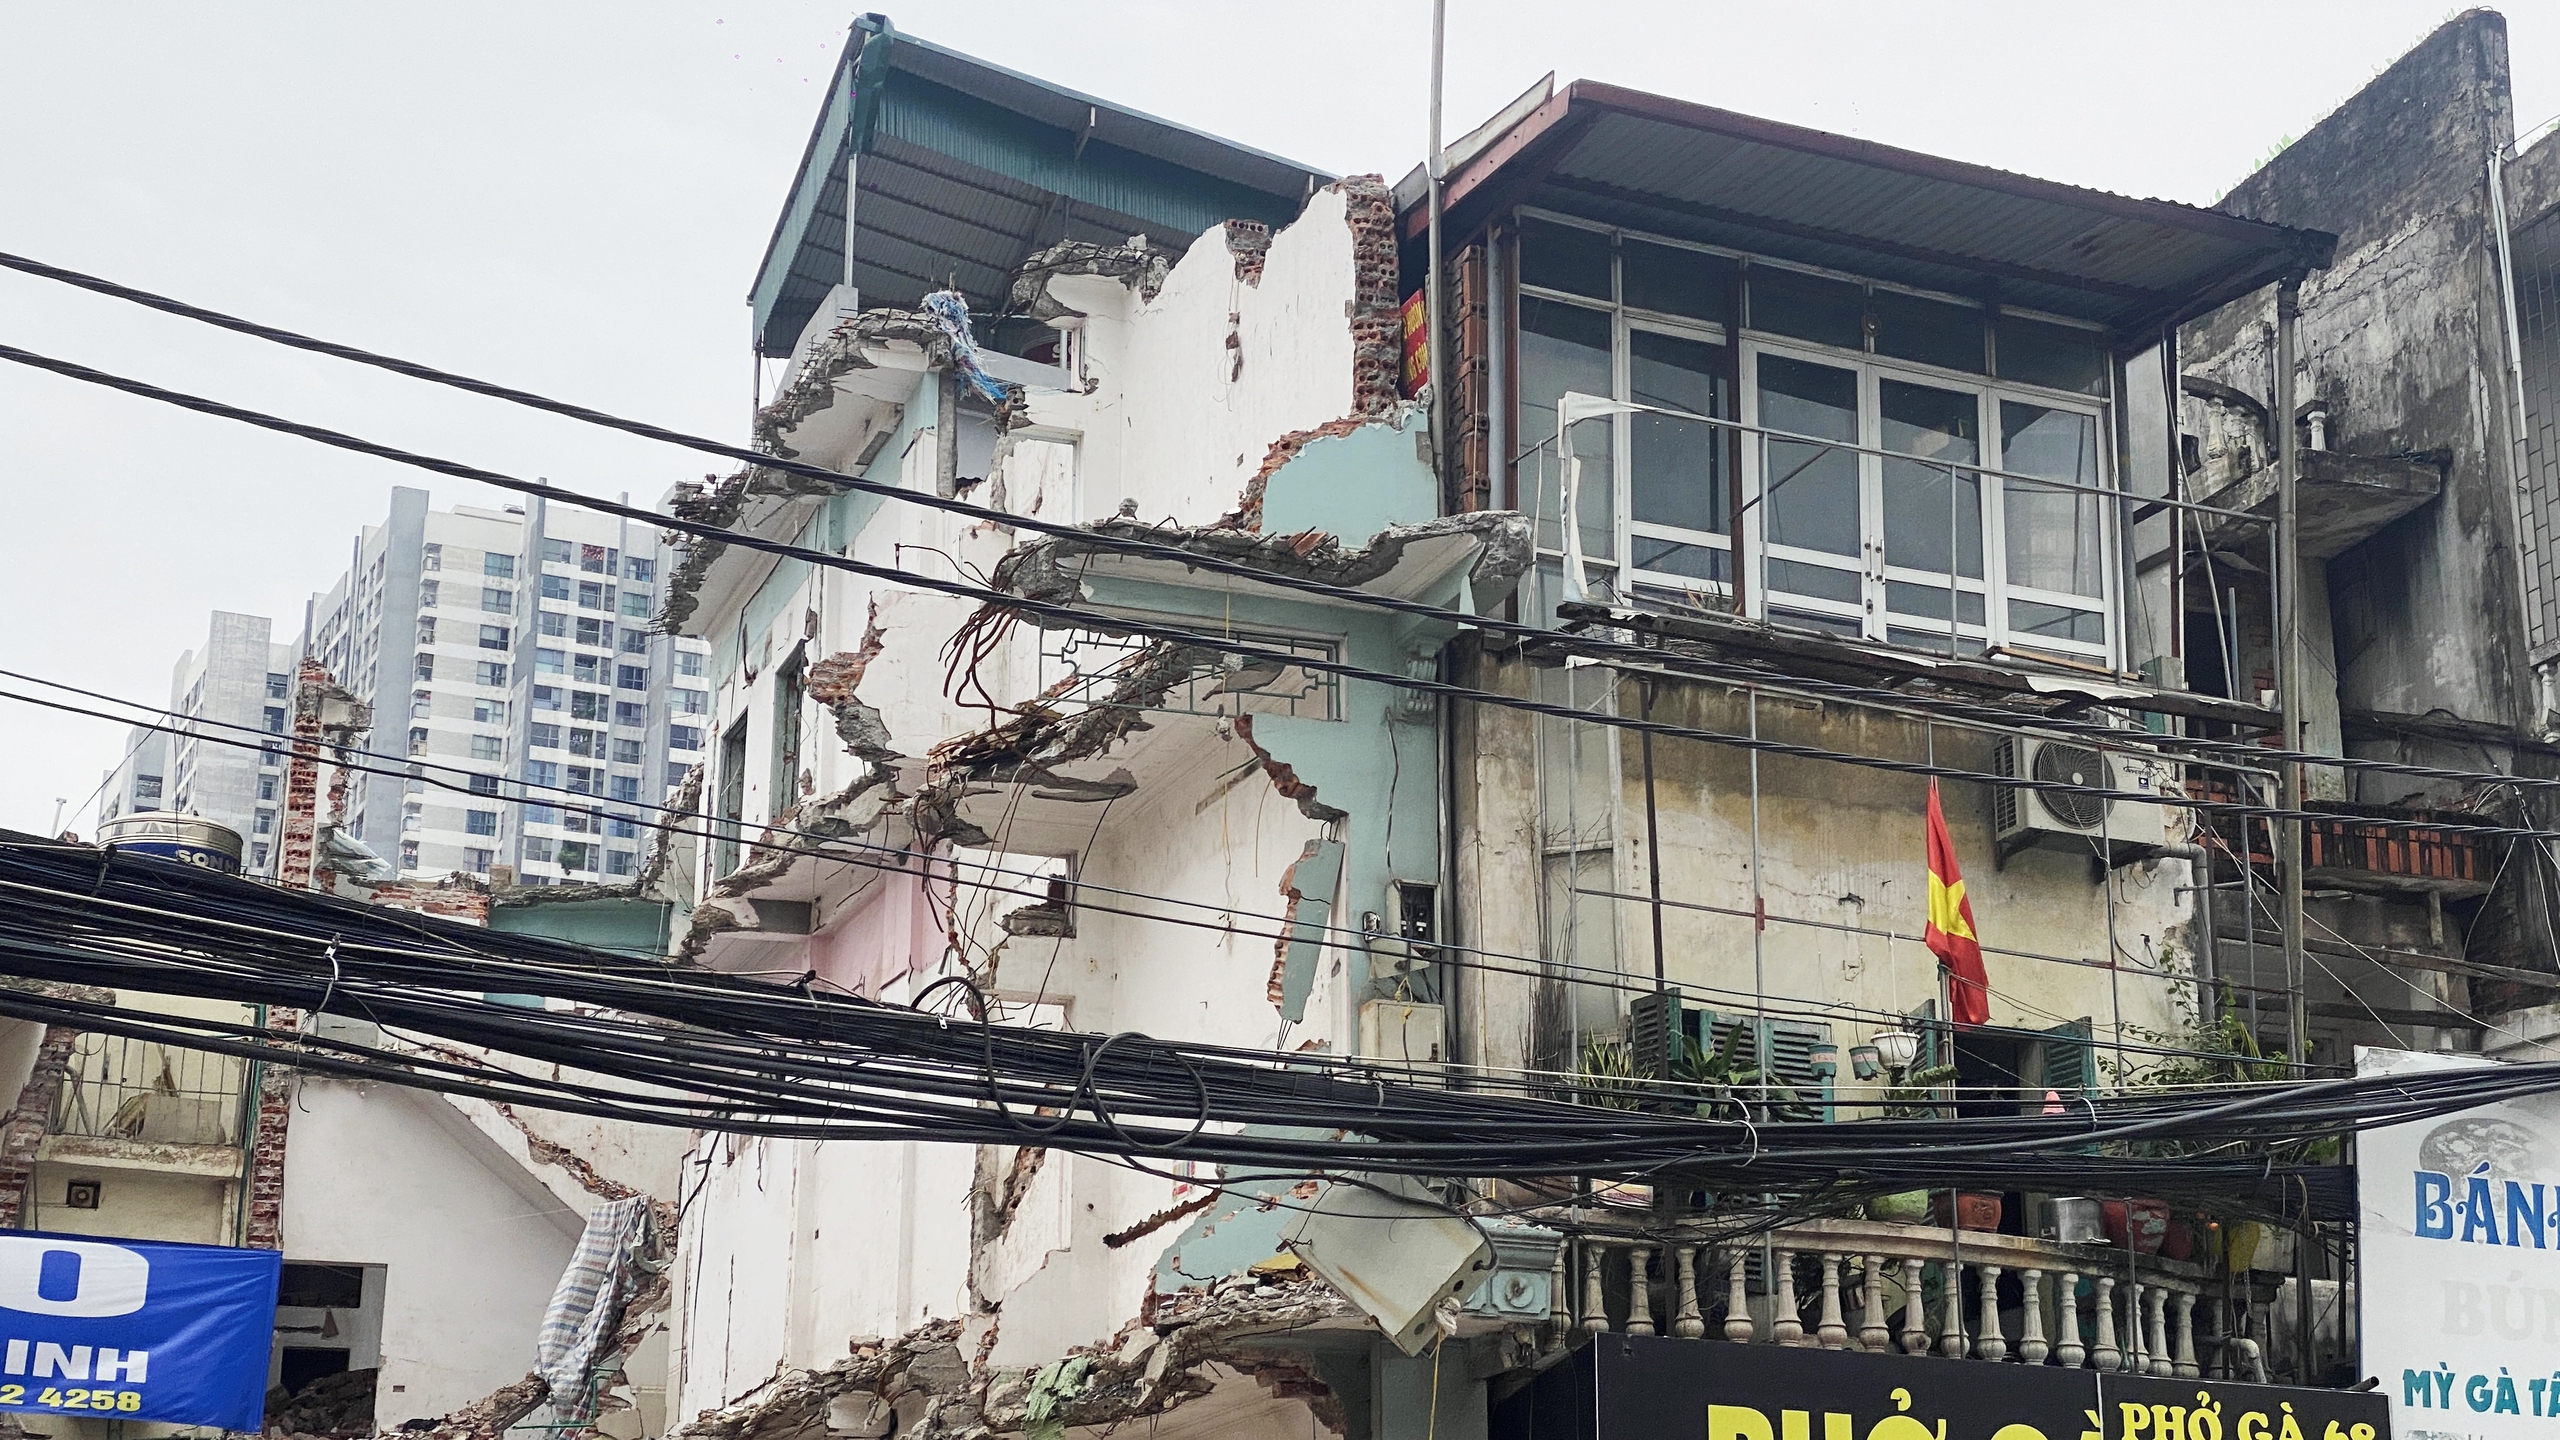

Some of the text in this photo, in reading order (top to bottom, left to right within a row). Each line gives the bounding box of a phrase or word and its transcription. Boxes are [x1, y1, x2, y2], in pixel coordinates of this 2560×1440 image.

[2414, 1162, 2560, 1250] BÁN
[37, 1387, 142, 1412] 4258
[2403, 1361, 2456, 1410] MỲ
[2465, 1366, 2520, 1415] GÀ
[2118, 1390, 2222, 1440] PHỞ
[2237, 1402, 2304, 1440] GÀ
